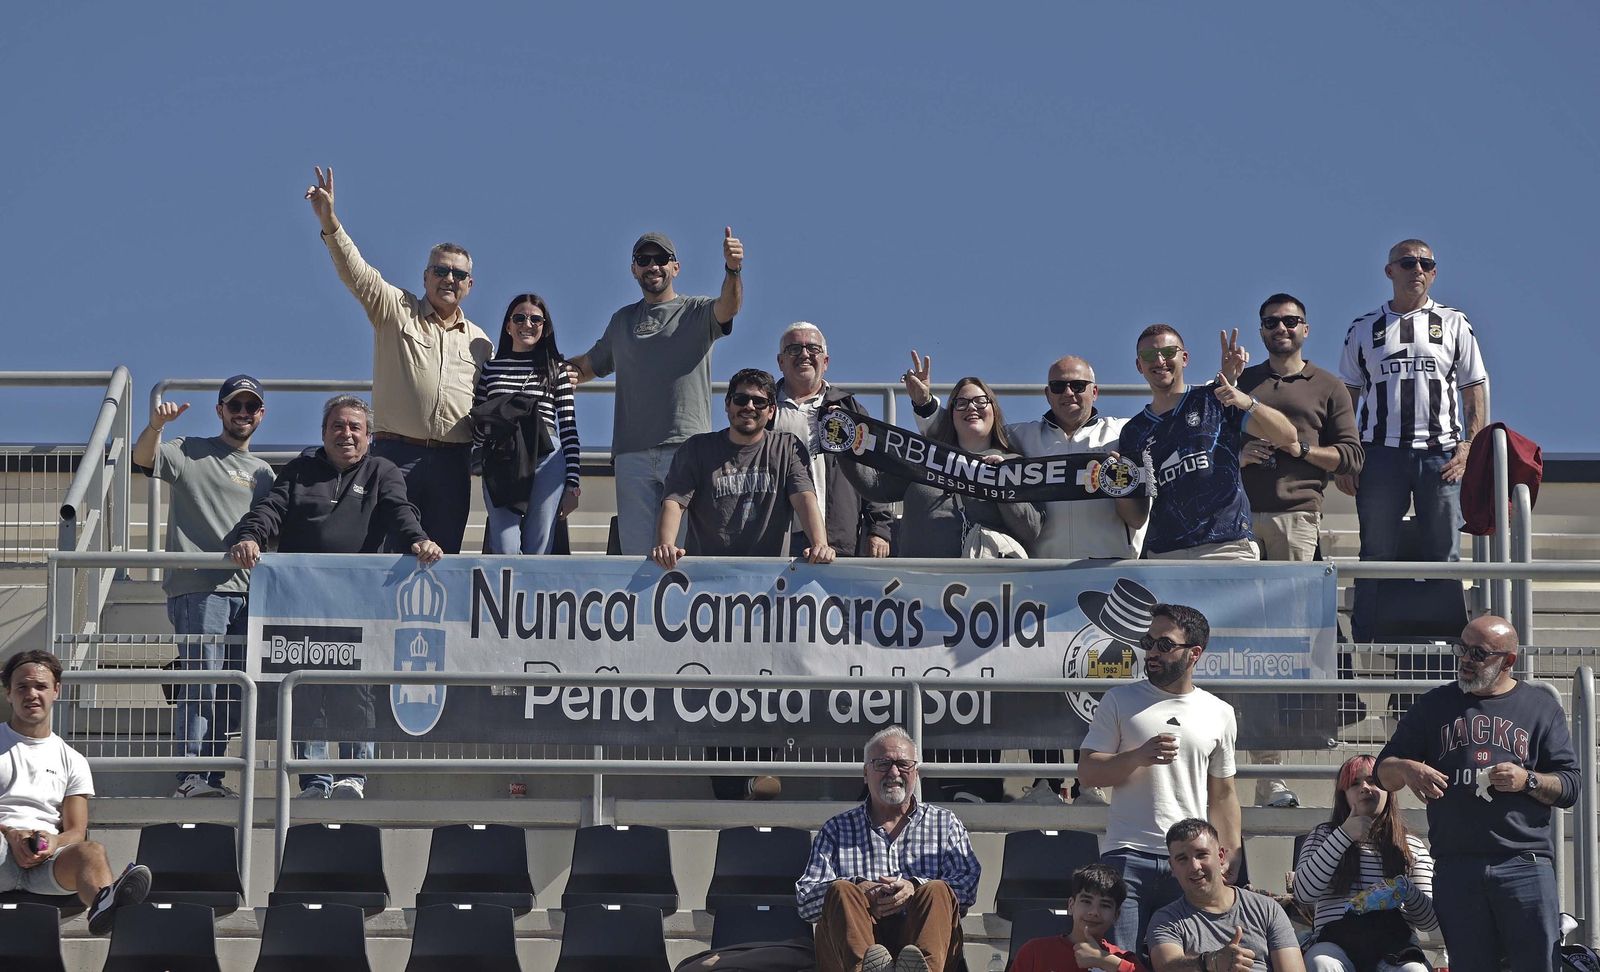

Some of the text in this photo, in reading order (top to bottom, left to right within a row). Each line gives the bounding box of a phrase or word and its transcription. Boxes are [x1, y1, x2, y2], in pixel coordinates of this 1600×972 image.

[1380, 360, 1436, 375] LOTUS
[884, 429, 1067, 487] RBLINENSE
[1158, 454, 1210, 487] LOTUS
[926, 471, 1016, 500] DESDE 1912
[470, 567, 1047, 649] Nunca Caminarás Sola
[269, 634, 355, 666] Balona
[1228, 646, 1295, 677] Línea
[523, 661, 994, 726] Peña Costa del Sol
[1477, 751, 1488, 761] 90
